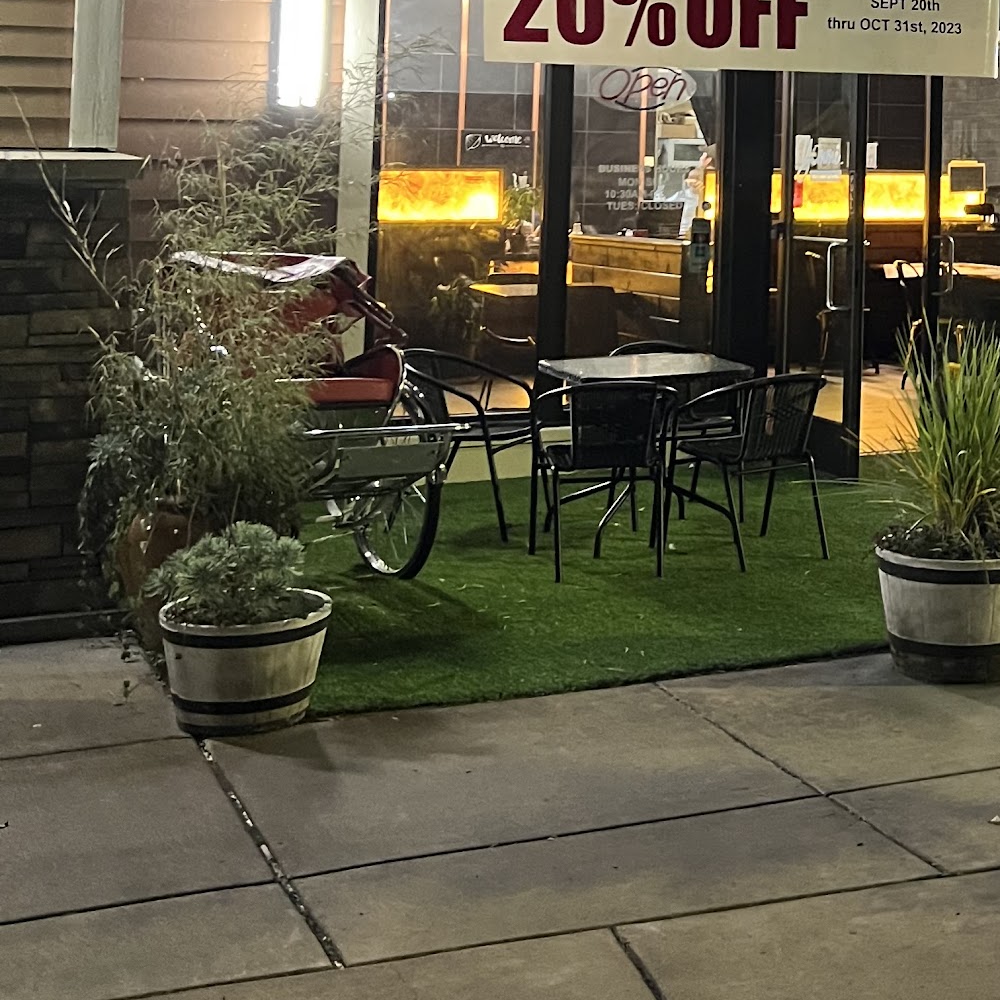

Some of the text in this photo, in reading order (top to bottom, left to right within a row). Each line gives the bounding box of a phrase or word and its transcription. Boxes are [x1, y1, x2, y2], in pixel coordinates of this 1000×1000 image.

[827, 17, 962, 35] thru OCT 31st, 2023
[642, 202, 683, 211] CLOSED
